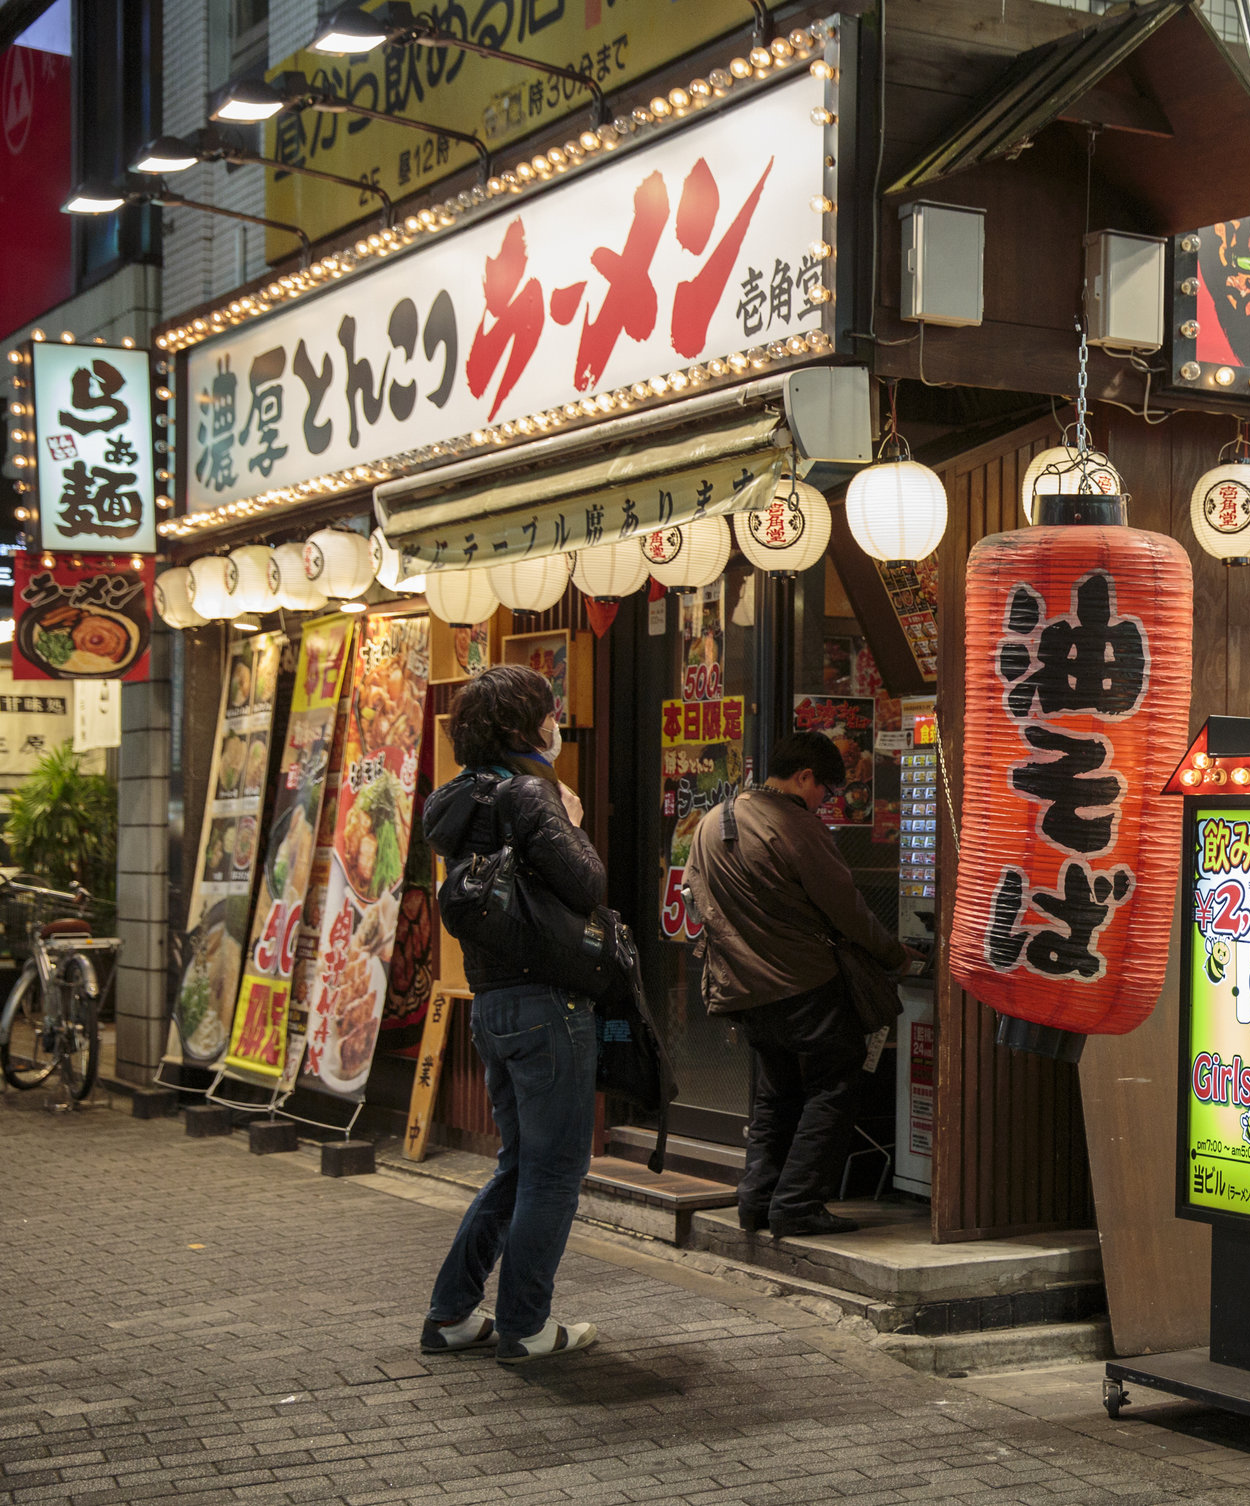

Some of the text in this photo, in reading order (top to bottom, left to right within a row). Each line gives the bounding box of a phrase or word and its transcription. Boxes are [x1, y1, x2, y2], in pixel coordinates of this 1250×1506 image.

[197, 154, 822, 494] 濃厚とんこつ ラーメン 壱角堂
[55, 358, 145, 539] らぁ麺
[1217, 485, 1239, 528] 壱角堂
[649, 530, 666, 559] 角堂
[663, 699, 743, 742] 本日限定
[986, 569, 1150, 982] 油そば
[1196, 1138, 1223, 1153] pm7:00
[1193, 1164, 1226, 1197] 当ビル
